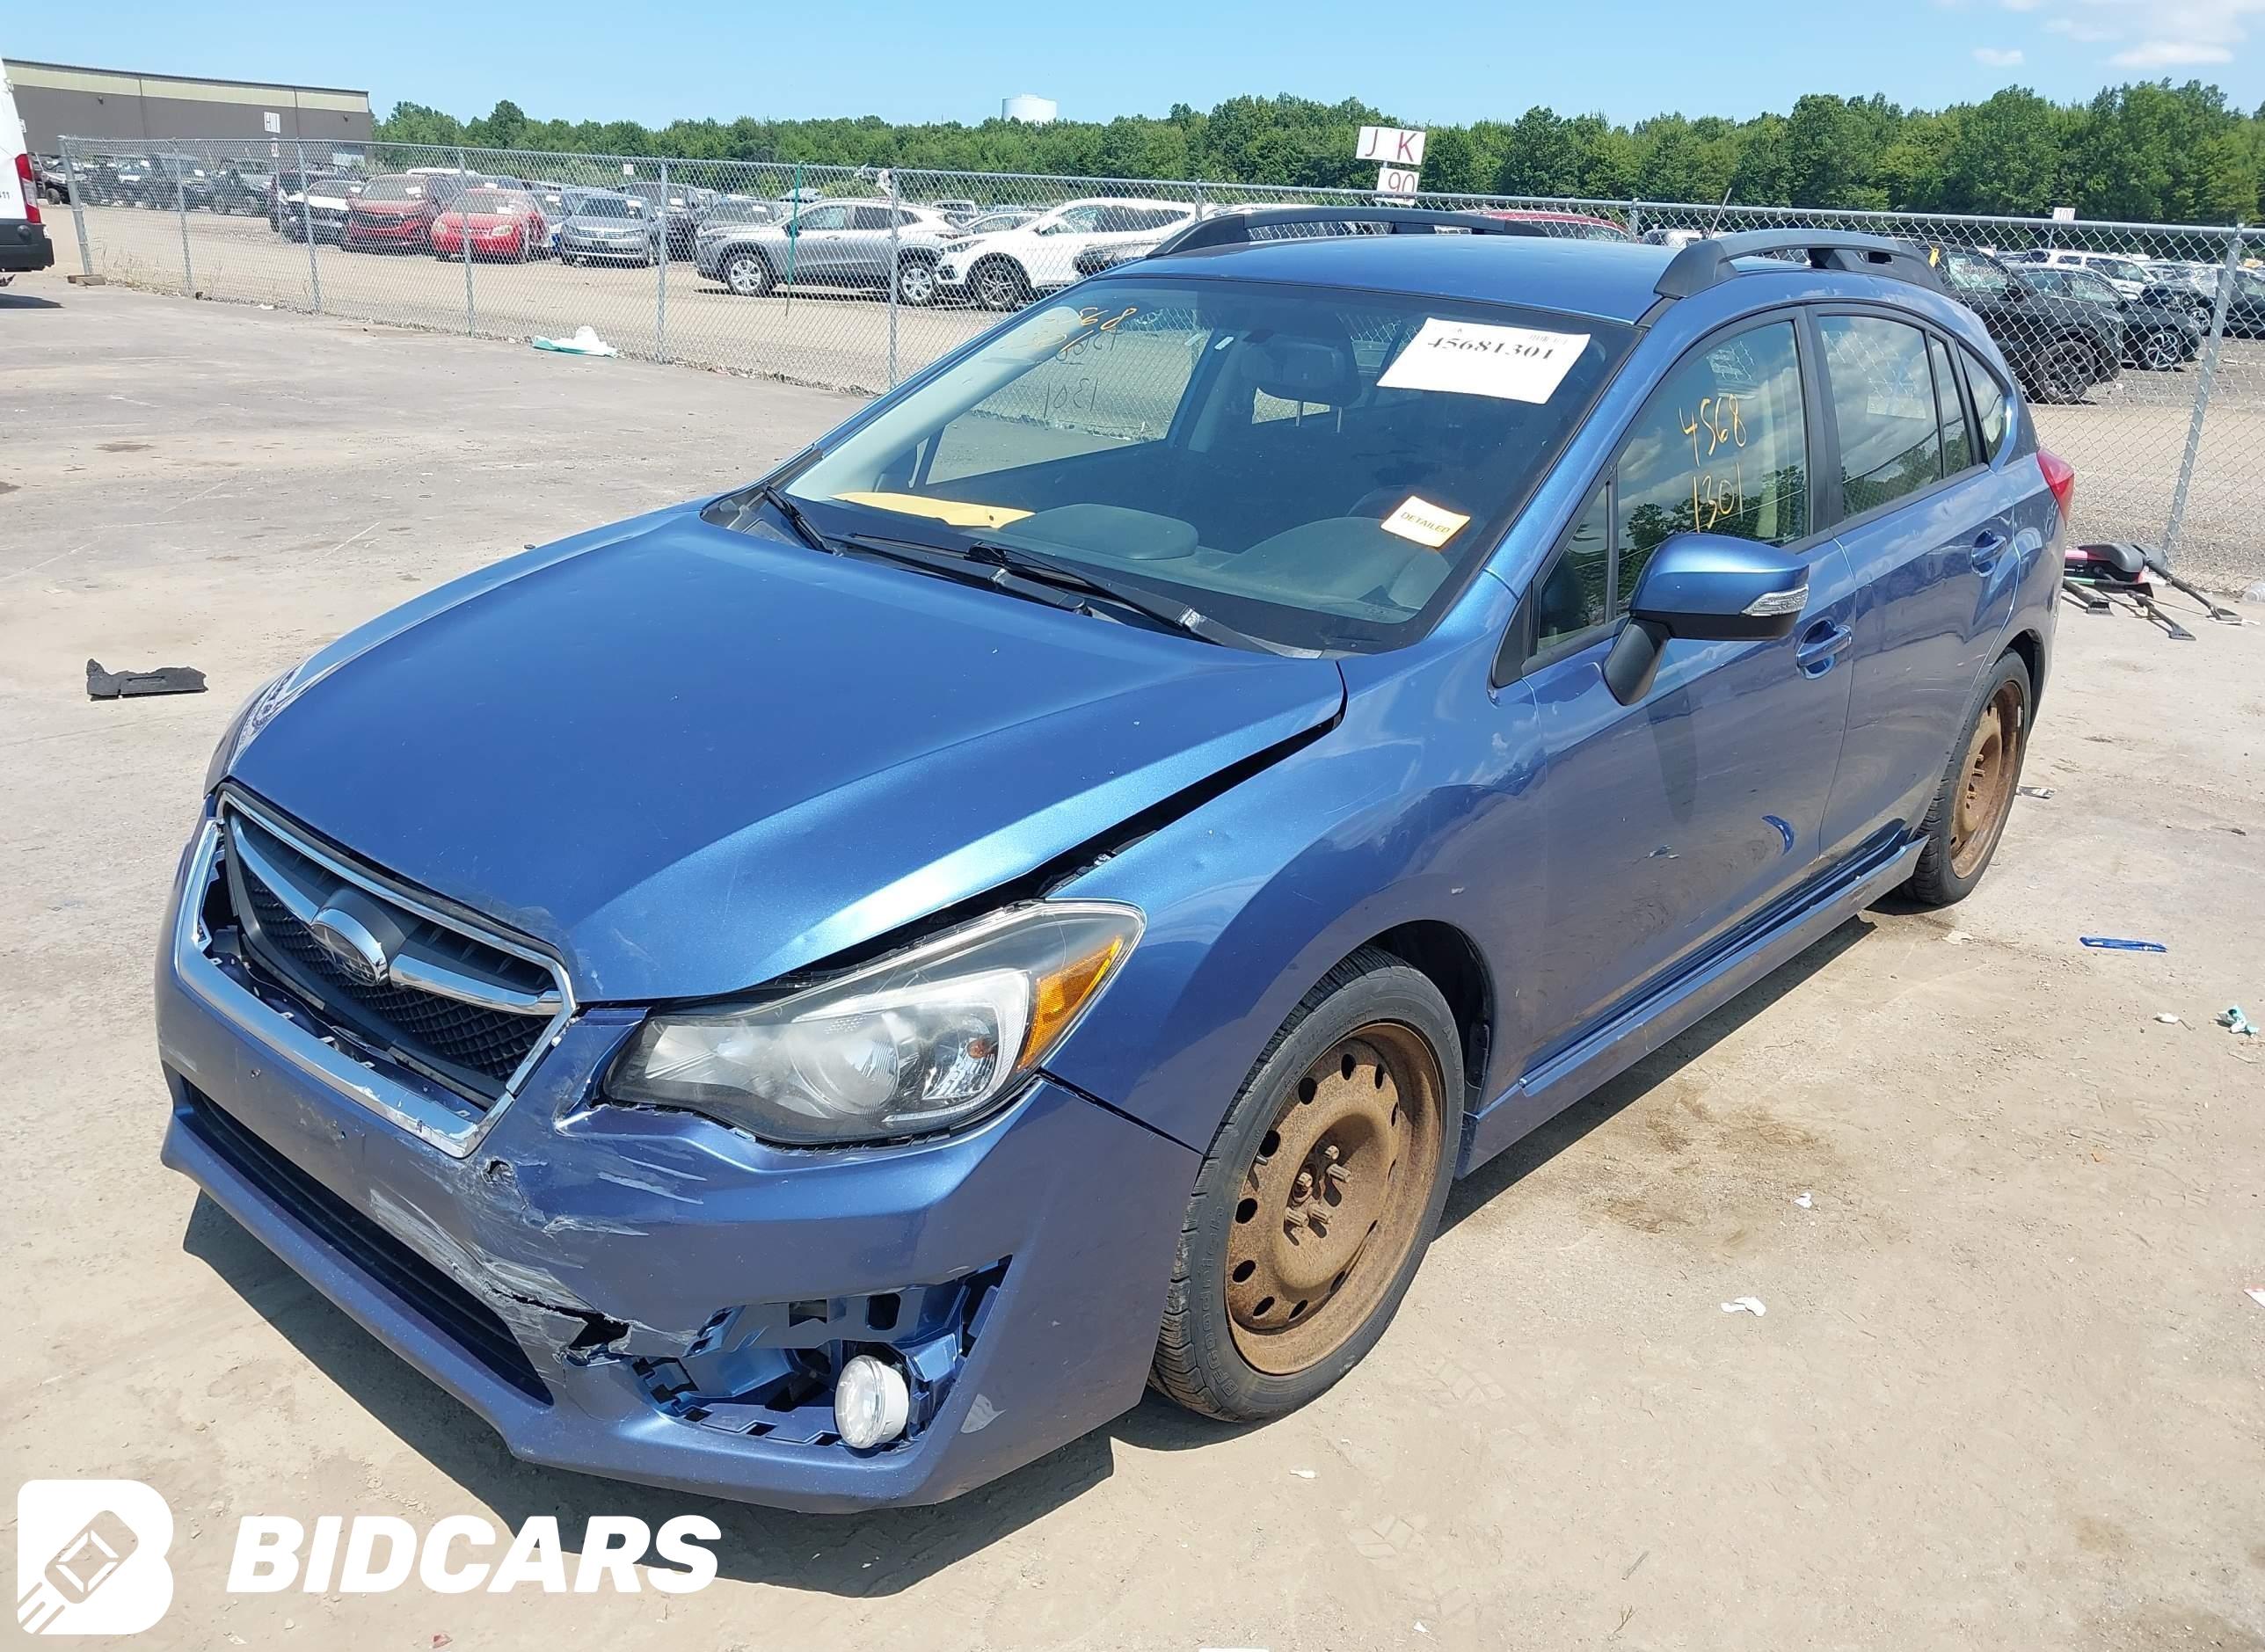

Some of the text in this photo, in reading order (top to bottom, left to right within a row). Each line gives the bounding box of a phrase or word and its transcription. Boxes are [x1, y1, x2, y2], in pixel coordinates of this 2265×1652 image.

[1365, 128, 1417, 163] J K
[1427, 336, 1555, 360] 45681301
[1679, 394, 1747, 467] 4568
[1693, 462, 1744, 533] 1301
[1400, 512, 1451, 533] DETAILED
